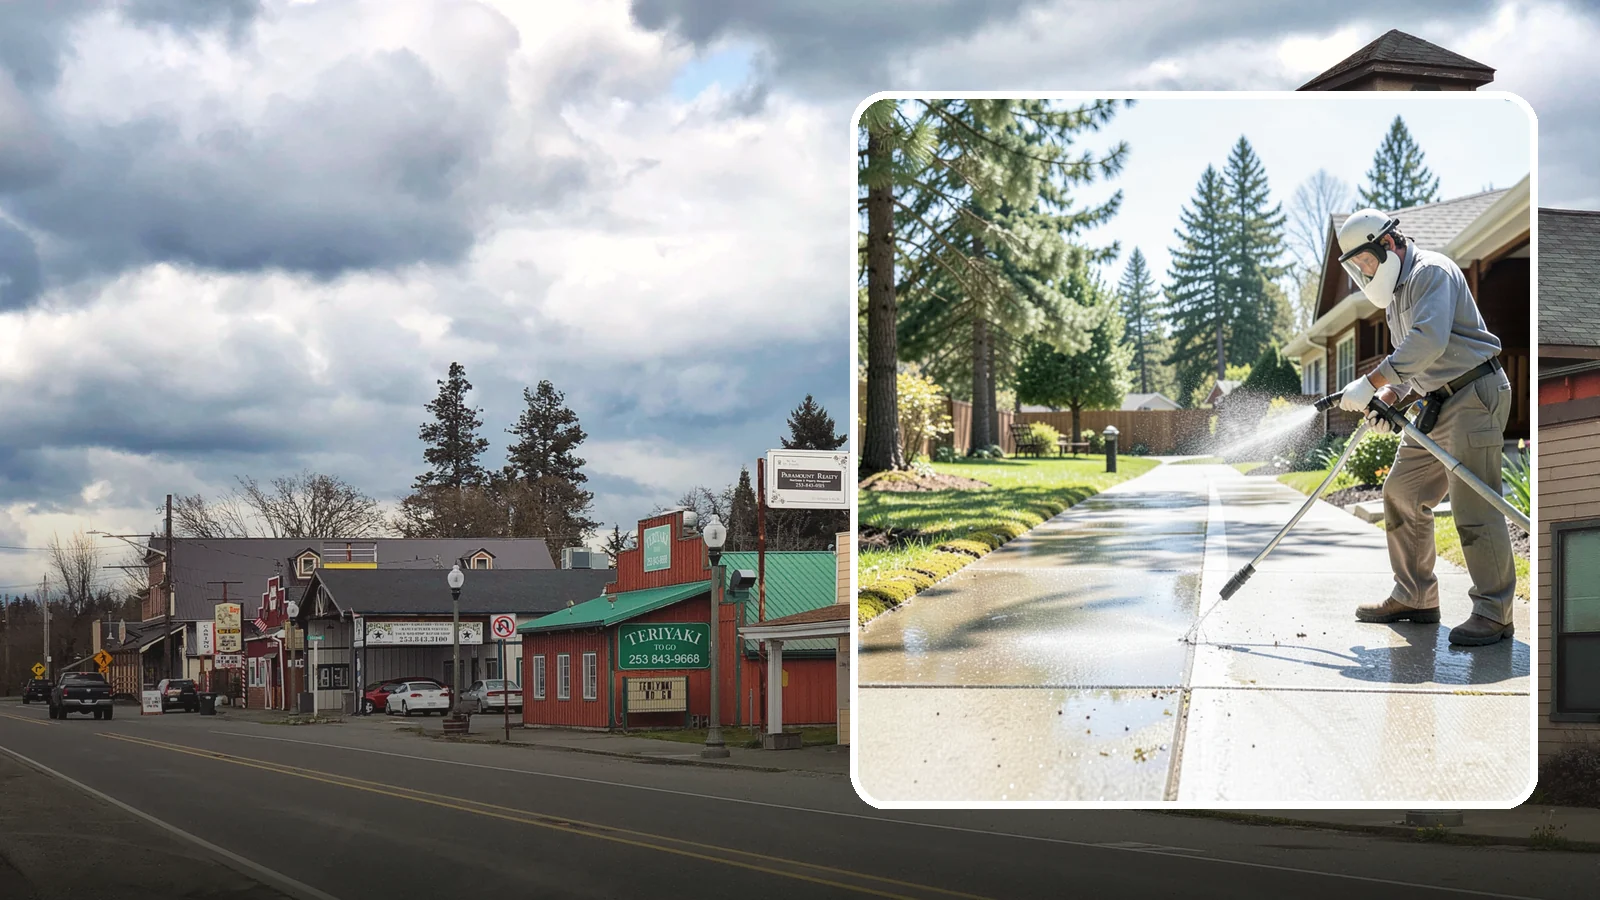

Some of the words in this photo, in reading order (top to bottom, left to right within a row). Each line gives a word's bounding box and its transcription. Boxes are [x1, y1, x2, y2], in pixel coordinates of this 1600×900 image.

[781, 471, 815, 479] PARAMOUNT
[817, 472, 839, 480] REALTY
[625, 627, 702, 646] TERIYAKI
[629, 654, 649, 664] 253
[651, 653, 700, 664] 843-9668
